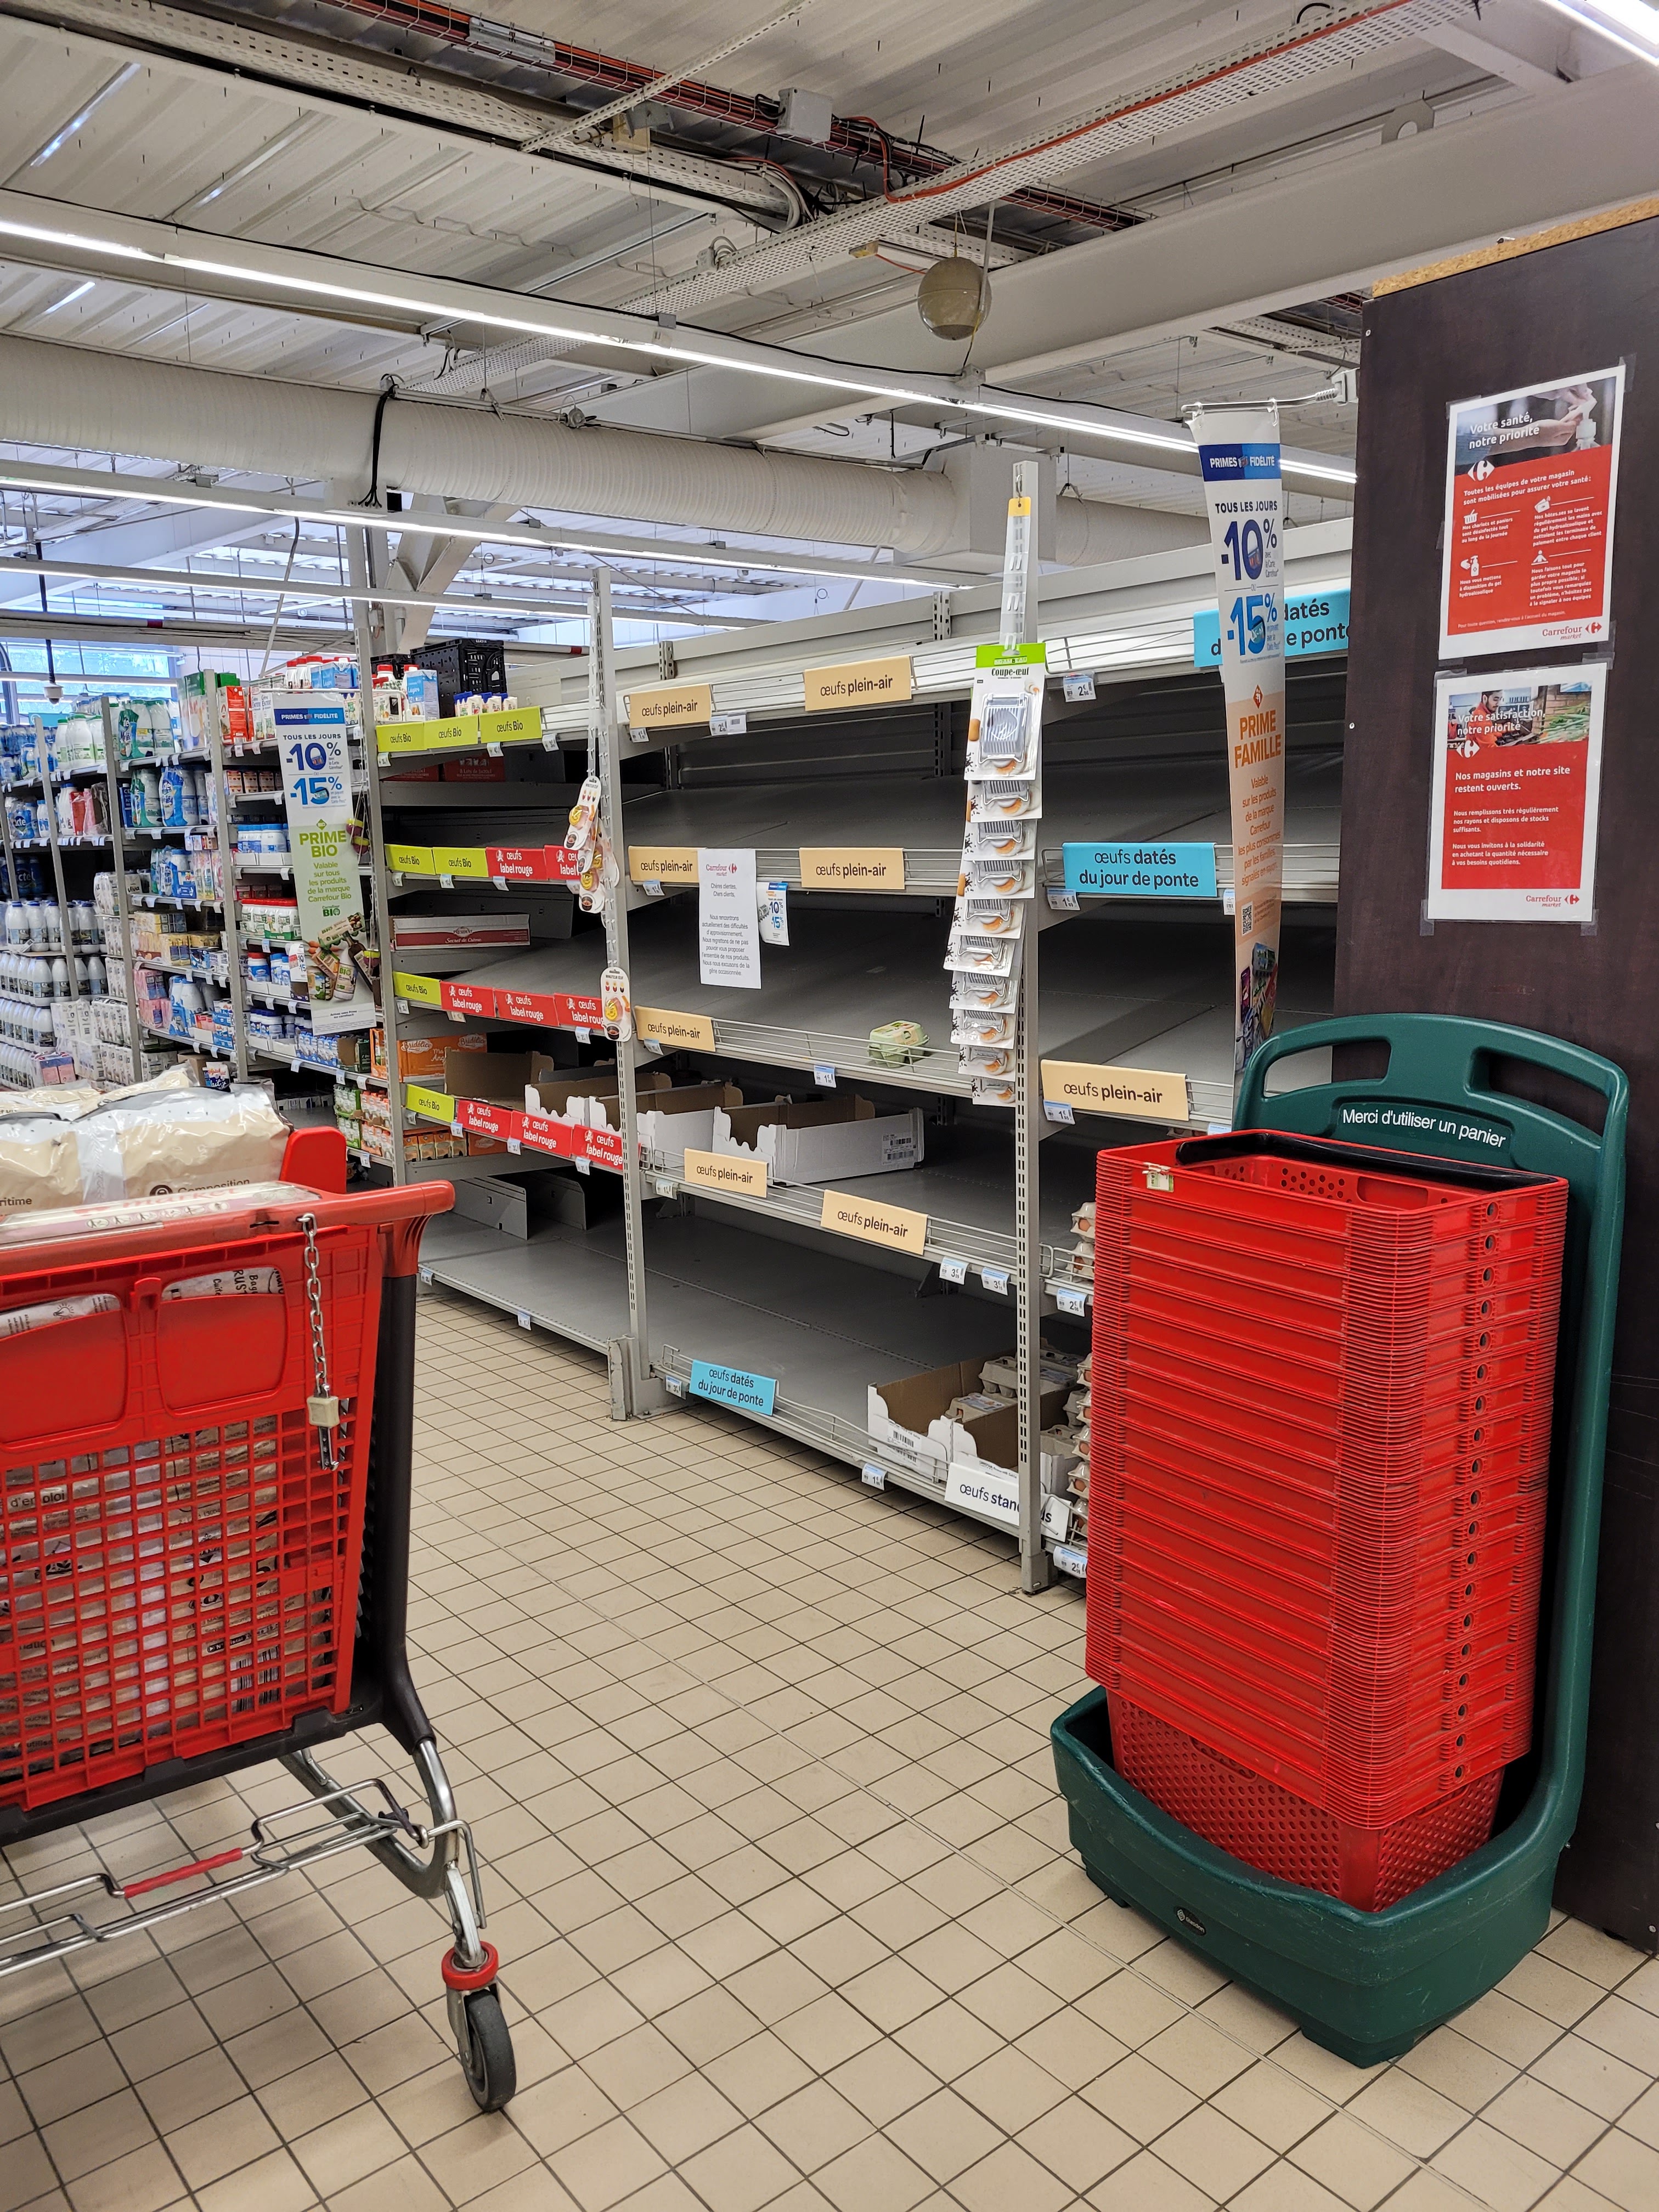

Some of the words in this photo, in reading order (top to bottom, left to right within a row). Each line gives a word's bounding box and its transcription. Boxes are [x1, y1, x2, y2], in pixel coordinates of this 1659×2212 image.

[1470, 422, 1498, 435] Votre
[1500, 411, 1533, 428] santé,
[1469, 437, 1497, 449] notre
[1499, 425, 1539, 444] priorité
[1210, 457, 1237, 469] PRIMES
[1250, 455, 1275, 466] FIDÉLITÉ
[1496, 482, 1519, 490] équipes
[1530, 475, 1547, 483] votre
[1549, 470, 1575, 479] magasin
[1478, 492, 1510, 503] mobilisées
[1511, 488, 1526, 497] pour
[1527, 484, 1550, 493] assurer
[1215, 503, 1238, 514] TOUS
[1240, 501, 1253, 512] LES
[1255, 500, 1277, 511] JOURS
[1543, 626, 1582, 636] Carrefour
[1286, 633, 1297, 646] e
[992, 667, 1029, 676] Coupe-œuf
[820, 685, 846, 698] œufs
[848, 675, 893, 697] plein-air
[641, 704, 663, 717] œufs
[663, 701, 698, 715] plein-air
[1458, 714, 1483, 723] Votre
[1486, 709, 1546, 721] satisfaction,
[497, 721, 512, 733] œufs
[513, 720, 523, 731] Bio
[1240, 709, 1276, 740] PRIME
[1457, 725, 1482, 735] notre
[1485, 721, 1521, 735] priorité
[391, 733, 403, 743] œufs
[403, 733, 411, 742] Bio
[439, 727, 452, 738] œufs
[453, 727, 462, 737] Bio
[1234, 734, 1282, 768] FAMILLE
[1473, 769, 1511, 780] magasins
[1526, 768, 1550, 776] notre
[1553, 766, 1570, 775] site
[1251, 775, 1268, 789] Valable
[1455, 784, 1485, 793] restent
[1486, 782, 1521, 791] ouverts.
[1259, 787, 1277, 805] produits
[1245, 811, 1252, 822] de
[1253, 808, 1257, 819] la
[1258, 804, 1275, 817] marque
[1250, 821, 1271, 836] Carrefour
[299, 831, 347, 845] PRIME
[311, 844, 338, 858] BIO
[507, 850, 522, 860] œufs
[1094, 849, 1131, 865] œufs
[1133, 848, 1176, 866] datés
[399, 855, 411, 864] œufs
[449, 857, 462, 867] œufs
[462, 858, 472, 868] Bio
[500, 864, 515, 873] label
[516, 865, 533, 877] rouge
[560, 864, 576, 876] label
[641, 860, 659, 872] œufs
[661, 860, 693, 874] plein-air
[816, 864, 842, 877] œufs
[843, 864, 887, 878] plein-air
[320, 878, 347, 887] produits
[1079, 870, 1098, 884] du
[1099, 870, 1129, 888] jour
[1132, 871, 1150, 885] de
[1153, 873, 1199, 888] ponte
[1526, 894, 1561, 903] Carrefour
[323, 909, 340, 917] BIO
[406, 984, 418, 993] œufs
[419, 985, 428, 995] Bio
[459, 988, 472, 997] œufs
[452, 997, 465, 1008] label
[466, 1002, 482, 1013] rouge
[516, 995, 532, 1005] œufs
[578, 1000, 596, 1011] œufs
[510, 1006, 525, 1017] label
[526, 1009, 543, 1022] rouge
[572, 1011, 588, 1023] label
[589, 1015, 603, 1027] roug
[647, 1023, 667, 1035] œufs
[667, 1026, 700, 1039] plein-air
[404, 1040, 432, 1049] Bridélice
[1064, 1082, 1098, 1097] œufs
[1102, 1083, 1163, 1104] plein-air
[419, 1098, 431, 1108] œufs
[431, 1102, 440, 1110] Bio
[477, 1107, 491, 1117] œufs
[469, 1115, 482, 1126] label
[482, 1120, 499, 1133] rouge
[533, 1120, 549, 1132] œufs
[1343, 1109, 1378, 1124] Merci
[1381, 1110, 1436, 1130] d'utiliser
[1438, 1119, 1456, 1135] un
[1458, 1125, 1506, 1148] panier
[523, 1129, 538, 1142] label
[539, 1135, 556, 1149] rouge
[597, 1135, 614, 1148] œufs
[586, 1143, 603, 1158] label
[603, 1151, 623, 1166] rouge
[697, 1164, 716, 1177] œufs
[718, 1167, 753, 1184] plein-air
[837, 1208, 864, 1226] œufs
[864, 1214, 909, 1238] plein-air
[709, 1368, 730, 1381] œufs
[731, 1373, 754, 1388] datés
[698, 1379, 709, 1391] du
[708, 1381, 726, 1396] jour
[727, 1387, 737, 1400] de
[738, 1392, 764, 1407] ponte
[960, 1483, 990, 1502] œufs
[991, 1494, 1052, 1523] stans
